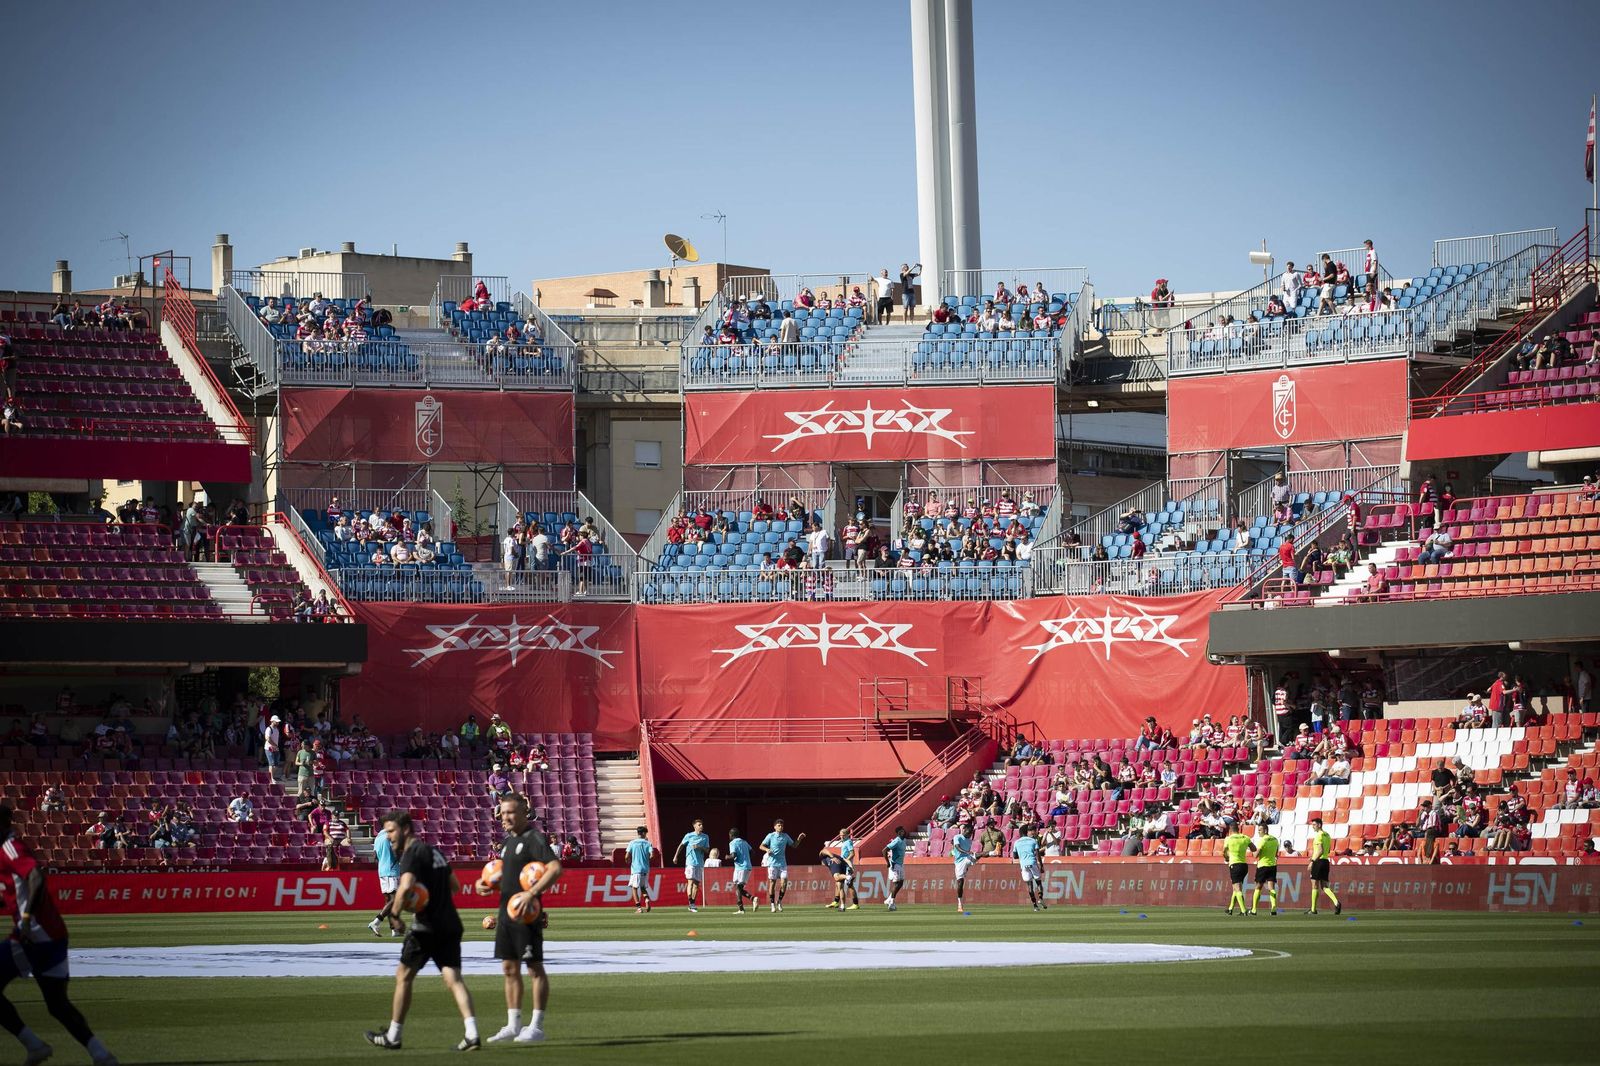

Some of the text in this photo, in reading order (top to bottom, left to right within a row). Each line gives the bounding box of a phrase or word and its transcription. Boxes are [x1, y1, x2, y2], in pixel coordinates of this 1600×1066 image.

[902, 878, 1021, 891] WE ARE NTRITION!
[1096, 879, 1229, 892] WE ARE NUTRITION!
[1348, 881, 1375, 894] ARE
[1382, 881, 1472, 895] NUTRITION!
[1487, 872, 1558, 905] HSN
[1571, 882, 1593, 895] WE
[58, 887, 257, 900] WE ARE NUTRITION!
[274, 877, 358, 906] HSN
